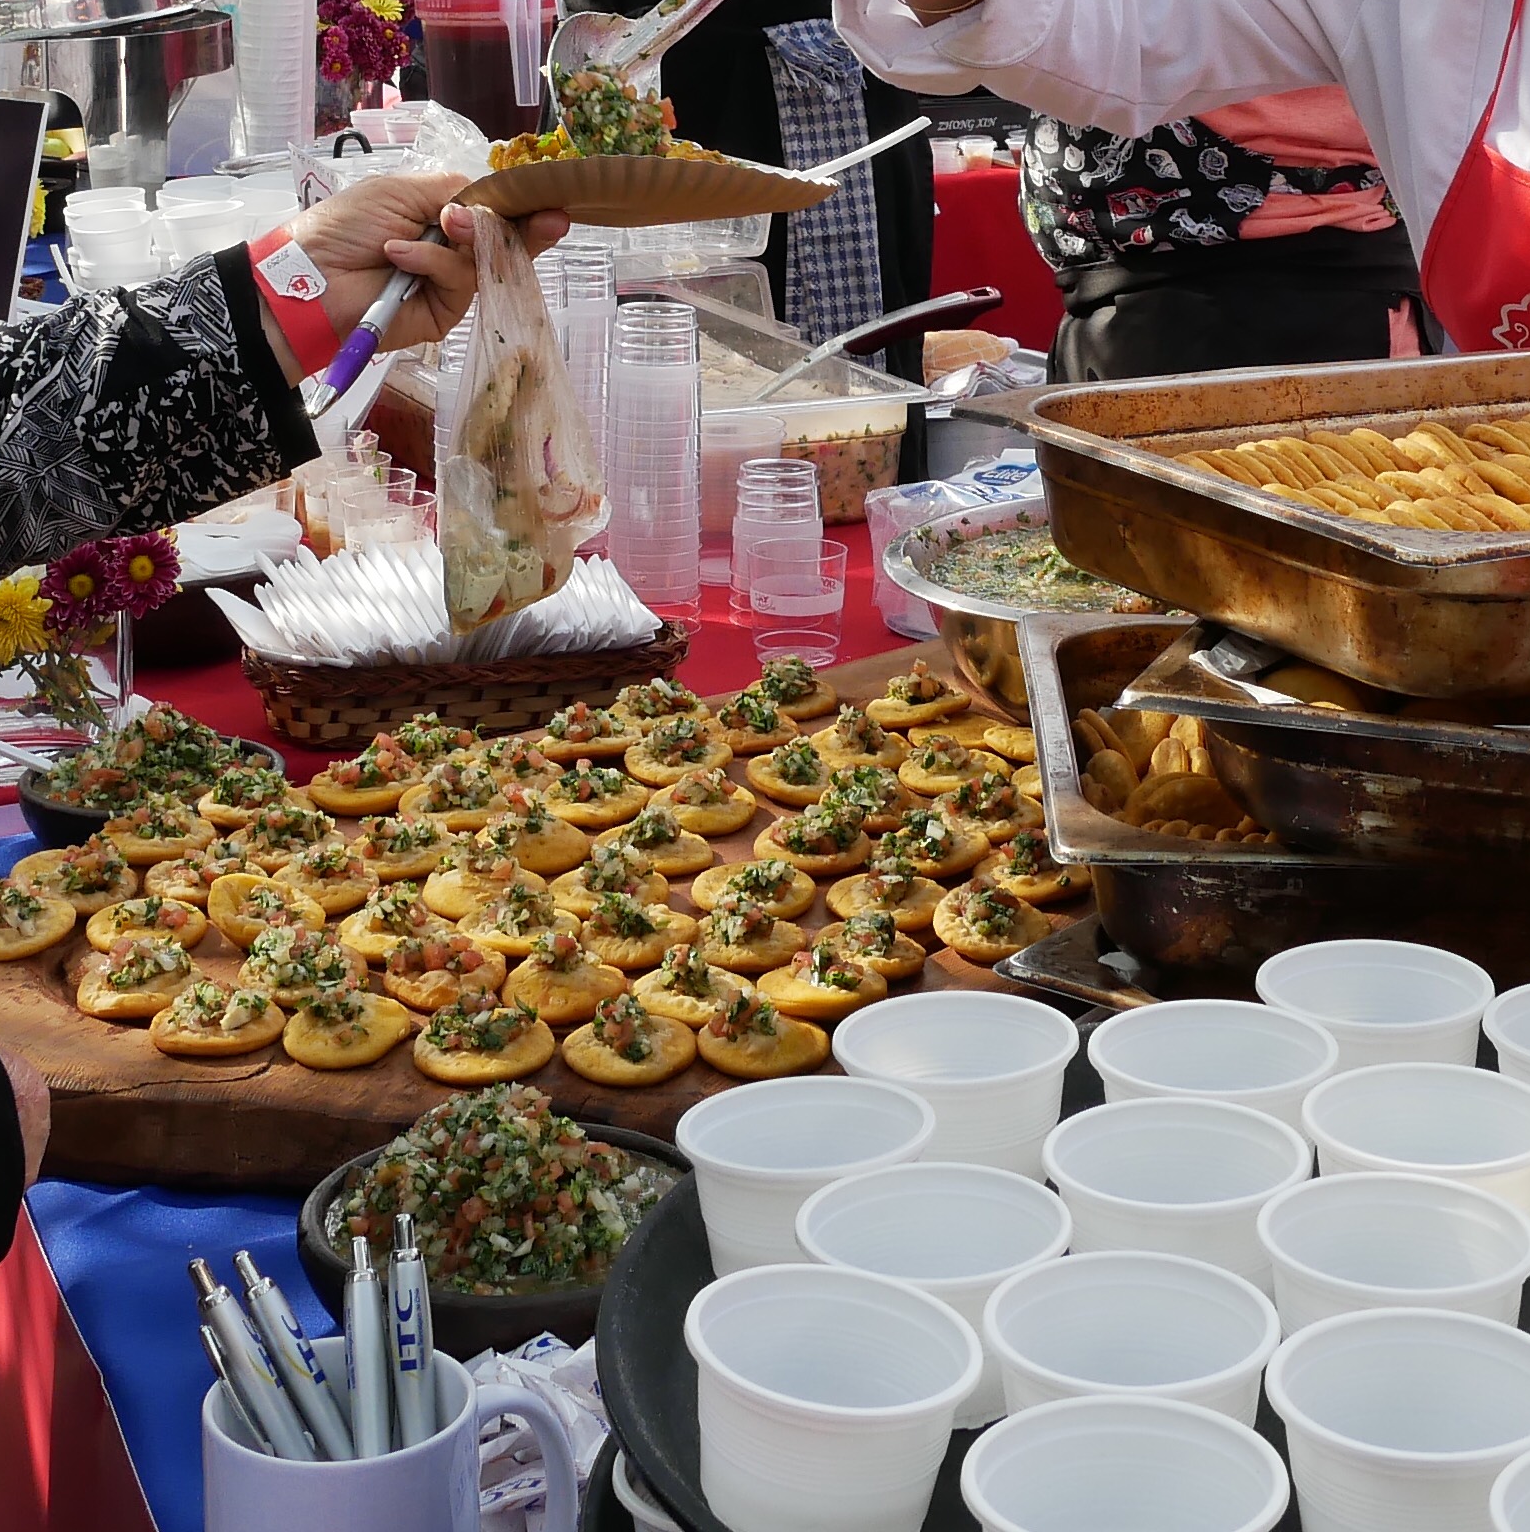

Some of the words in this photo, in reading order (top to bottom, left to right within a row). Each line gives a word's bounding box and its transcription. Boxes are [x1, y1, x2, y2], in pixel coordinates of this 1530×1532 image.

[937, 118, 975, 131] ZHONG
[976, 117, 997, 128] XIN
[281, 1315, 327, 1385] ITC
[395, 1288, 418, 1372] ITC
